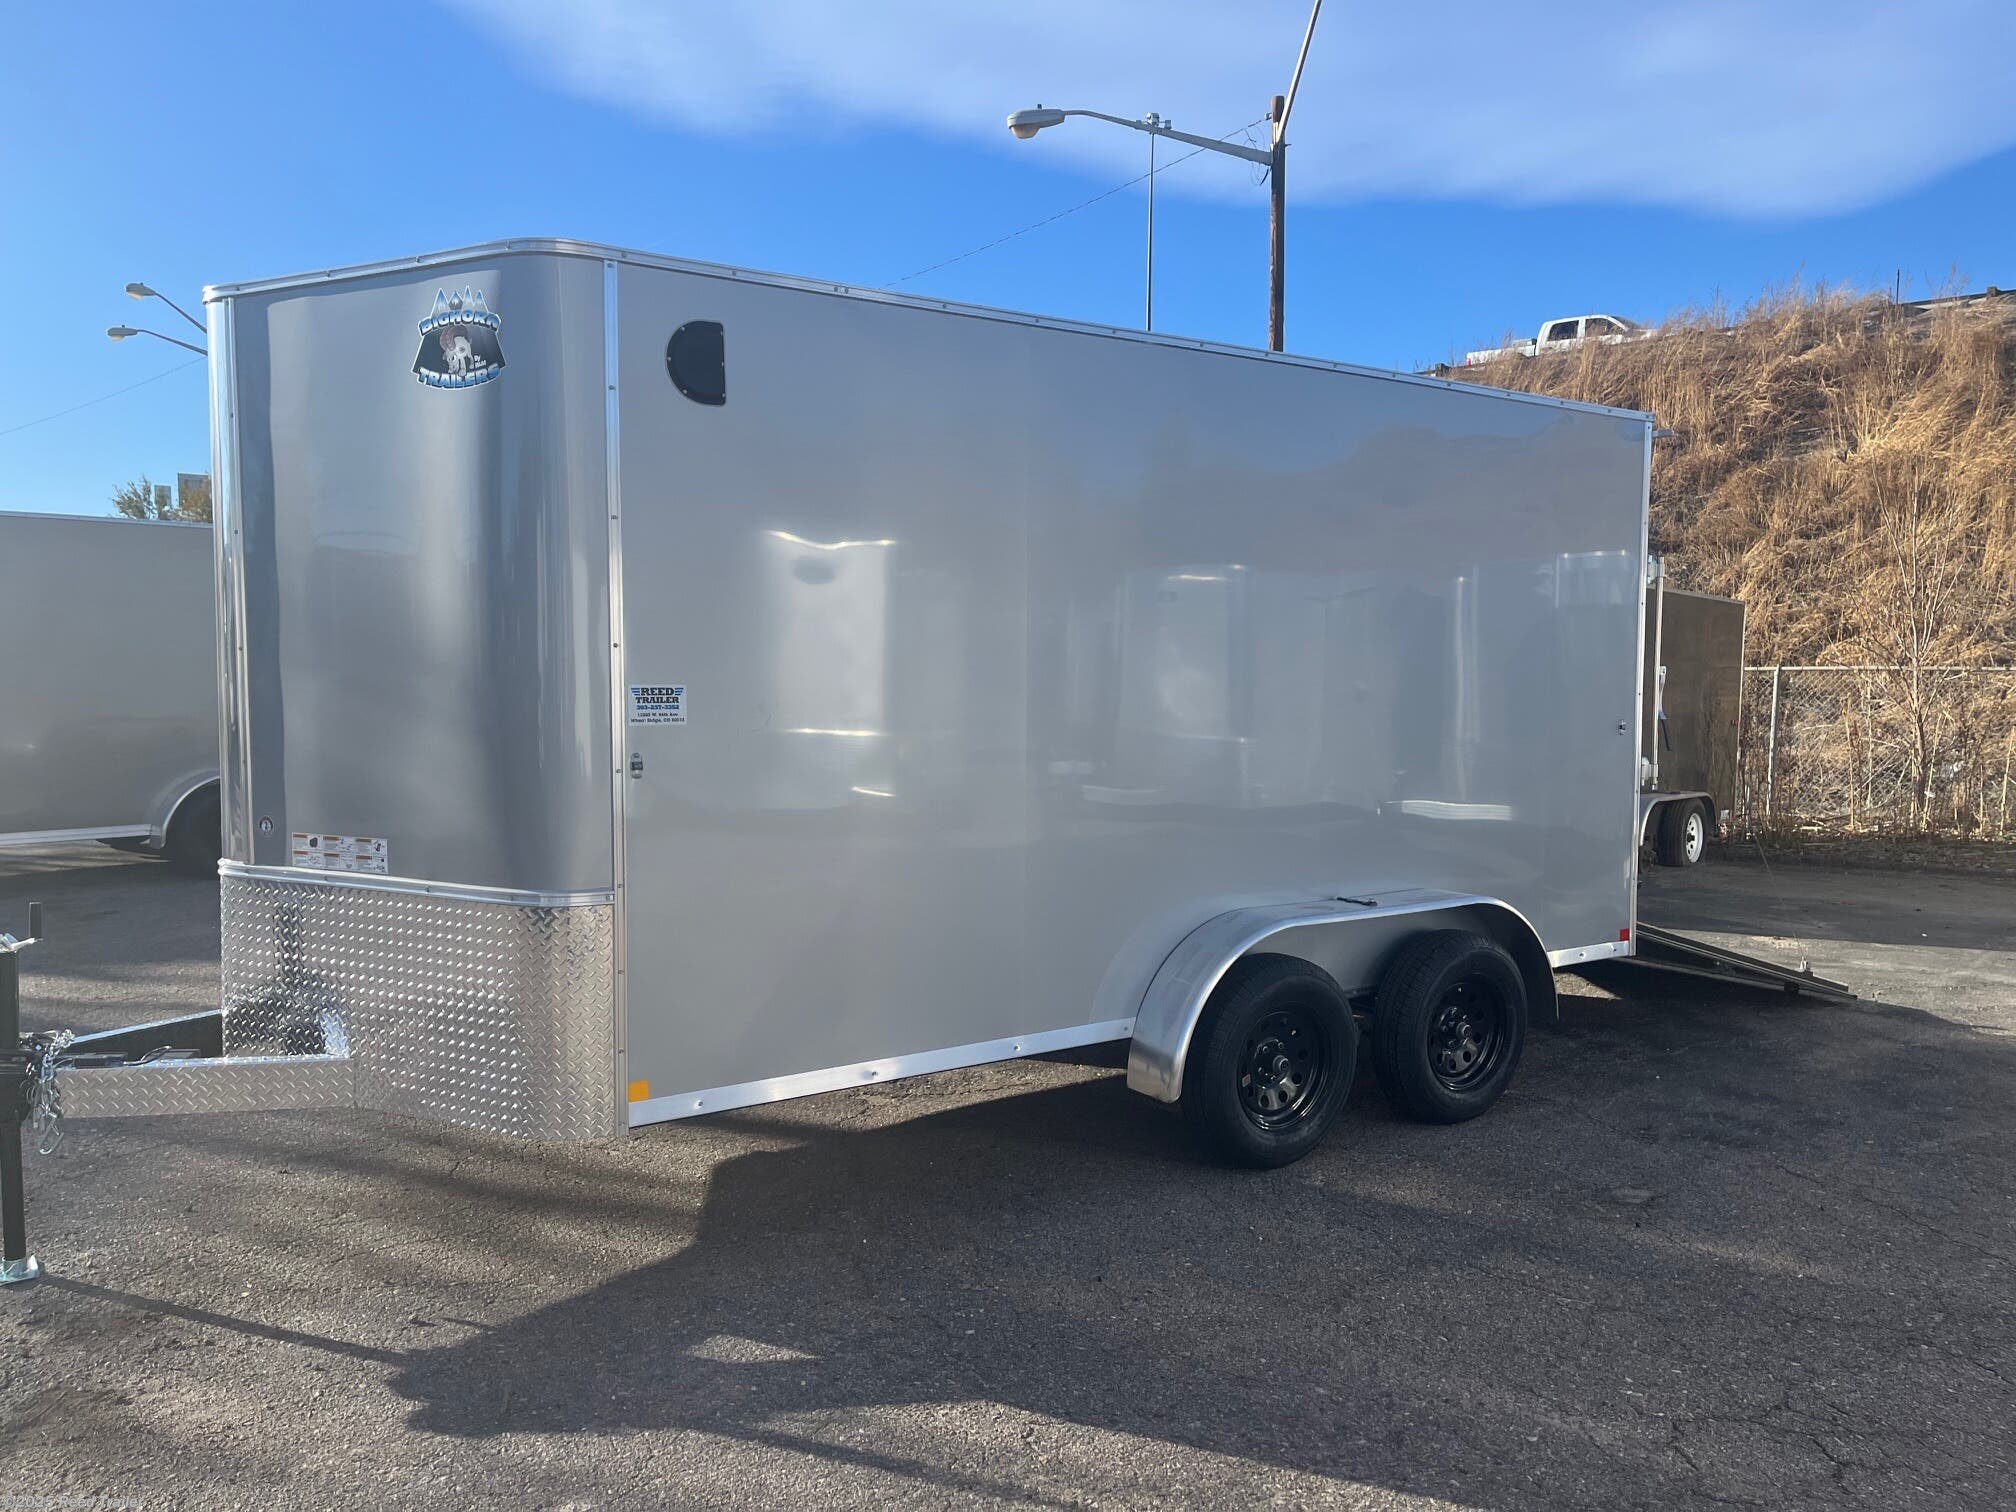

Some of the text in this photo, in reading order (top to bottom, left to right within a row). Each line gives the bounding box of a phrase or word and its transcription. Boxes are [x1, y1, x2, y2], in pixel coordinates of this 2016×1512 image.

[419, 310, 501, 336] BIGHORN
[418, 363, 501, 389] TRAILERS
[635, 696, 680, 704] TRAILER
[640, 687, 675, 696] REED
